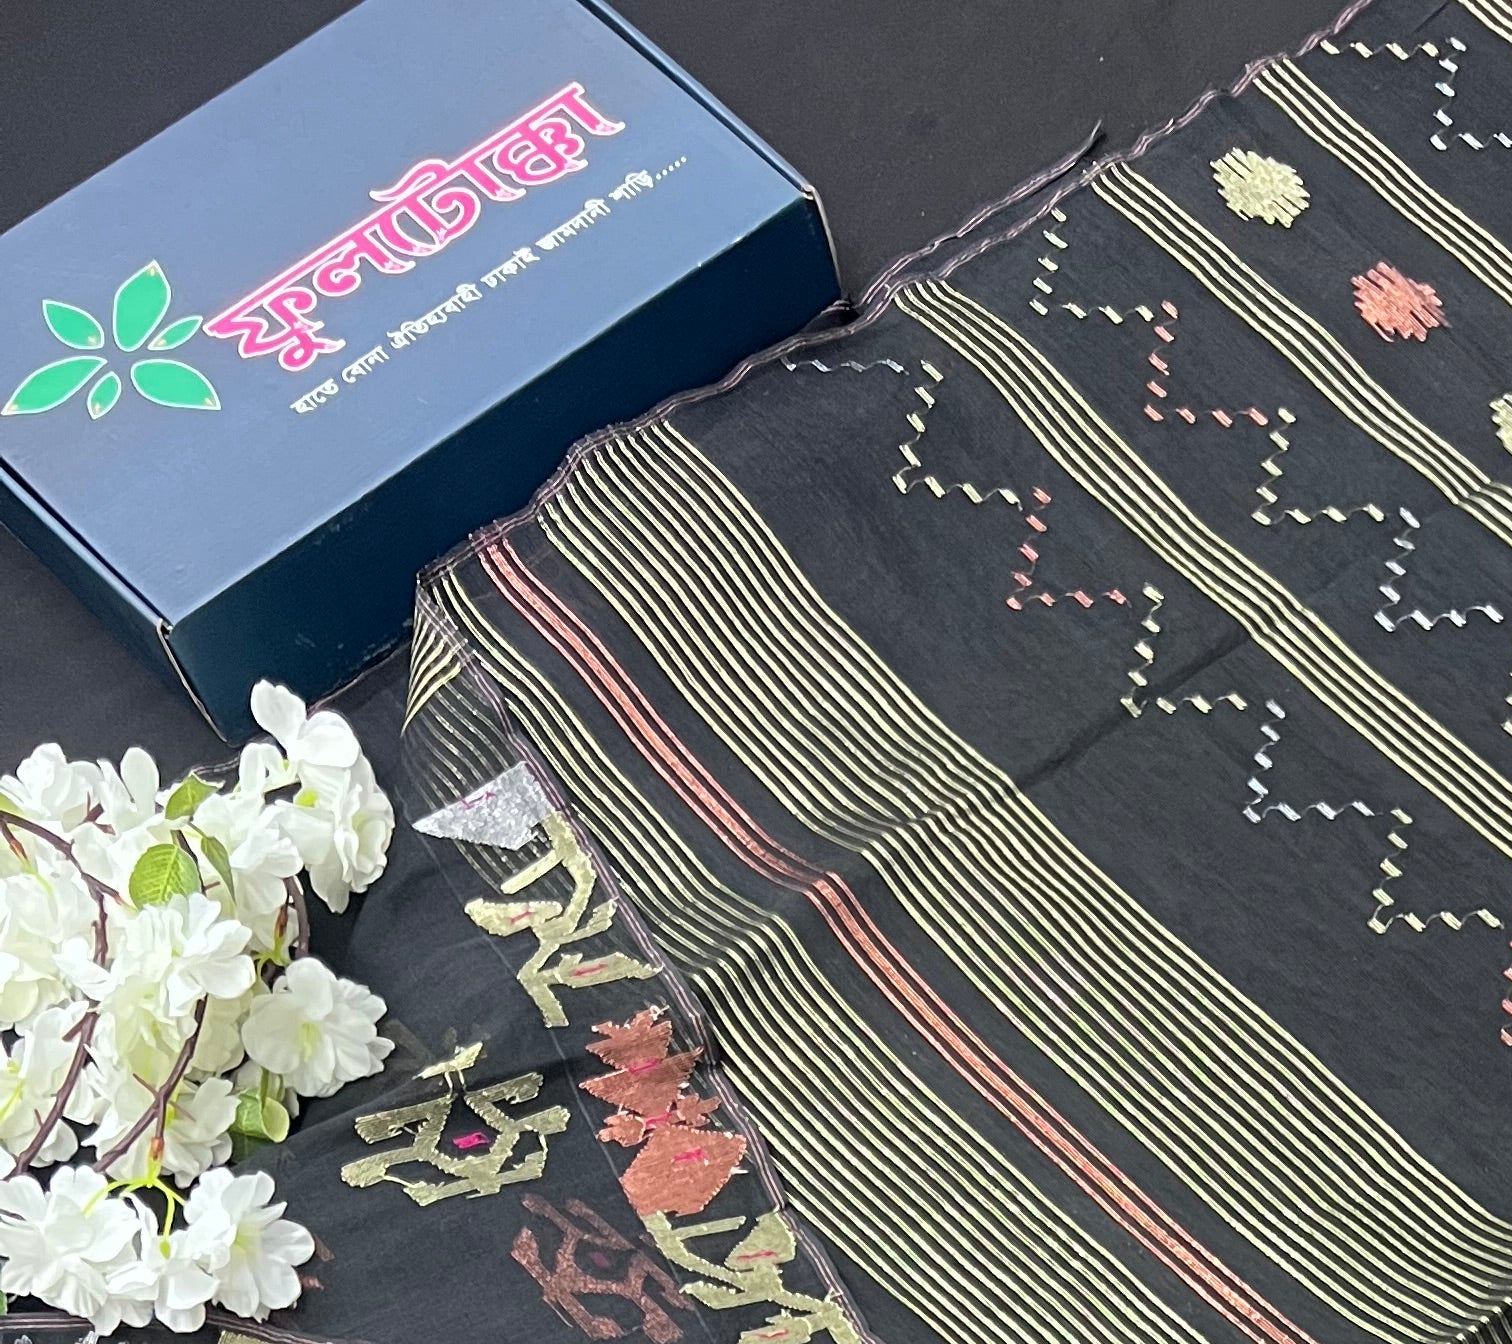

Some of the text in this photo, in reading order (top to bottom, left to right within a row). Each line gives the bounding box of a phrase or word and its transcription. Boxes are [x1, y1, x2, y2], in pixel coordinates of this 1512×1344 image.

[203, 82, 627, 372] ফুলটোক্কা
[290, 379, 339, 413] হাতে
[342, 345, 390, 384] বোনা
[387, 283, 483, 350] ঐতিহ্যবাহী
[479, 247, 541, 289] ঢাকাই
[535, 198, 611, 250] জামদানী
